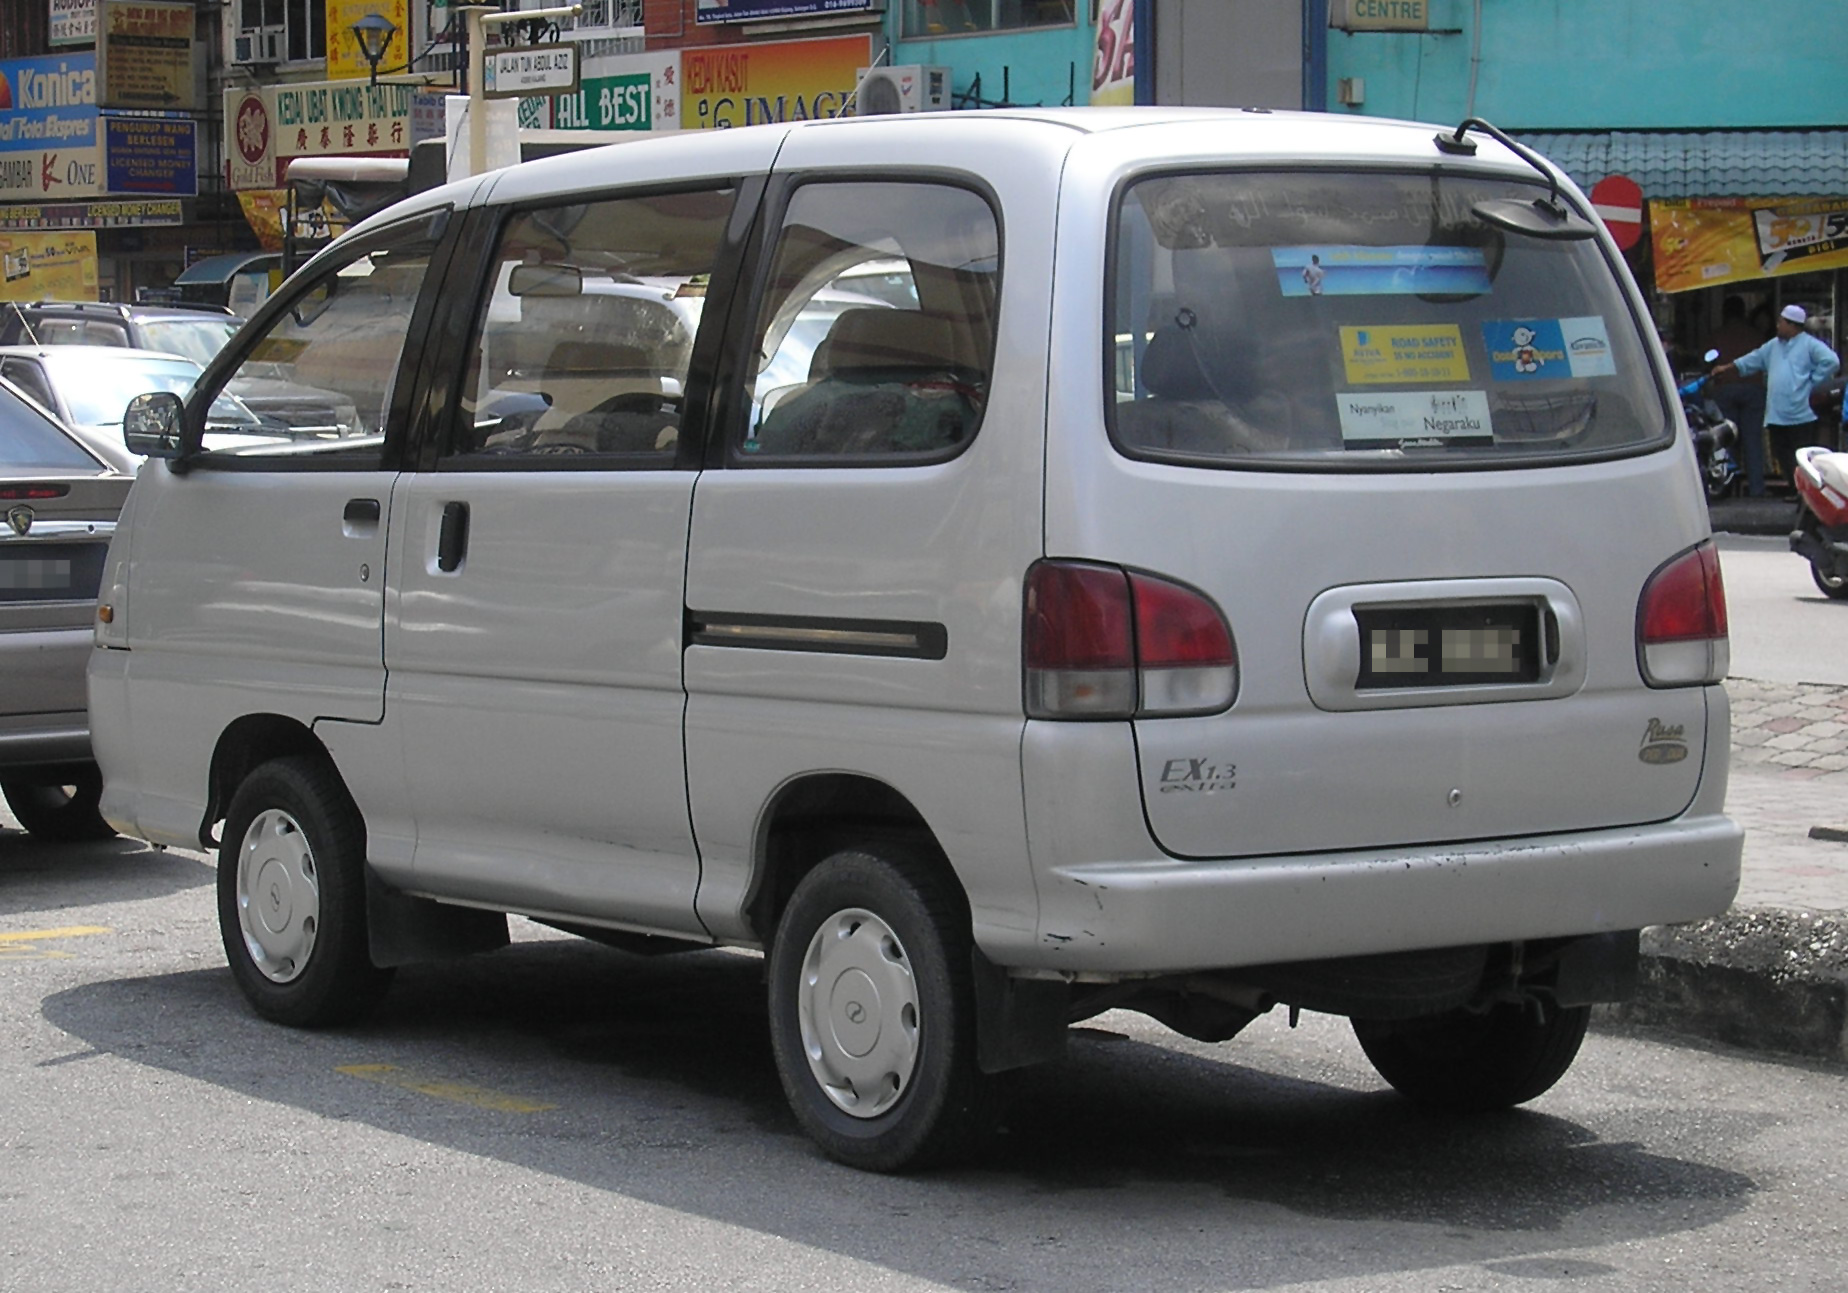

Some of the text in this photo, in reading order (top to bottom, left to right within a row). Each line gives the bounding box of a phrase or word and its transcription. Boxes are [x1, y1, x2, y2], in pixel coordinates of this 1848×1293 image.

[1356, 0, 1422, 19] CENTRE
[500, 53, 569, 73] JALAN TUN ABDUL AZIZ
[687, 53, 749, 94] KEDAI KASUT
[18, 62, 96, 109] Konica
[276, 92, 304, 126] KEDAI
[306, 89, 329, 123] UBAT
[331, 86, 363, 122] KWONG
[558, 90, 589, 128] ALL
[600, 84, 648, 125] BEST
[1391, 338, 1457, 348] ROAD SAFETY
[1349, 402, 1395, 417] Nyanyikan
[1423, 415, 1481, 434] Negaraku
